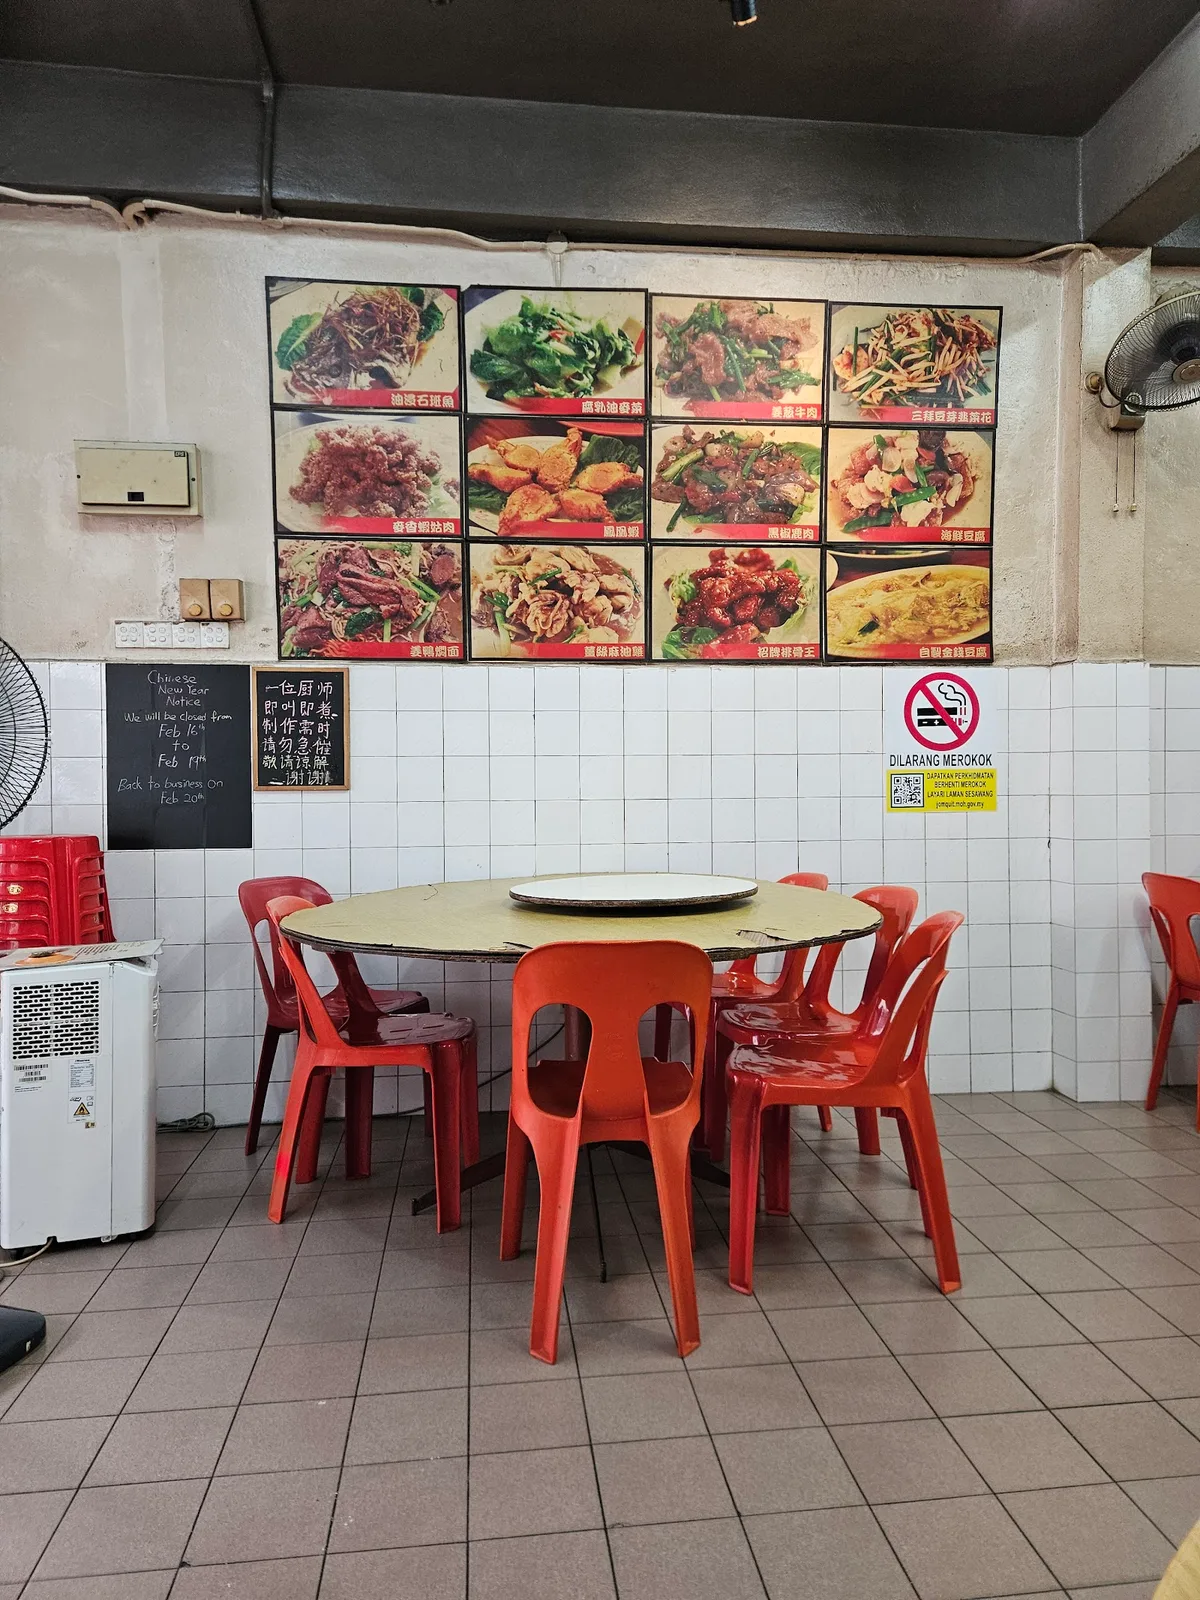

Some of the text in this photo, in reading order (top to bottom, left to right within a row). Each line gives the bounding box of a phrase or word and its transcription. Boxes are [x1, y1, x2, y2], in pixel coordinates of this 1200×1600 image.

[941, 529, 986, 542] 海鮮豆腐
[757, 646, 815, 658] 招牌排骨王
[148, 670, 198, 684] Chinese
[158, 685, 209, 695] New Year
[265, 680, 333, 701] 一位厨师
[166, 696, 201, 707] Notice
[124, 710, 232, 722] We will be closed from
[264, 700, 335, 720] 即叫即煮
[159, 723, 205, 738] Feb 16th
[262, 717, 331, 739] 制作需时
[172, 739, 190, 751] to
[262, 735, 332, 755] 请勿急催
[158, 754, 207, 771] Feb 19th
[262, 755, 330, 771] 敬请谅解
[889, 754, 992, 767] DILARANG MEROKOK
[927, 772, 994, 780] DAPATKAN PERKHIDMATAN
[117, 776, 143, 792] Back
[148, 776, 161, 791] to
[165, 777, 203, 789] business
[161, 791, 205, 804] Feb 20th
[927, 790, 994, 798] LAYARI LAMAN SESAWANG
